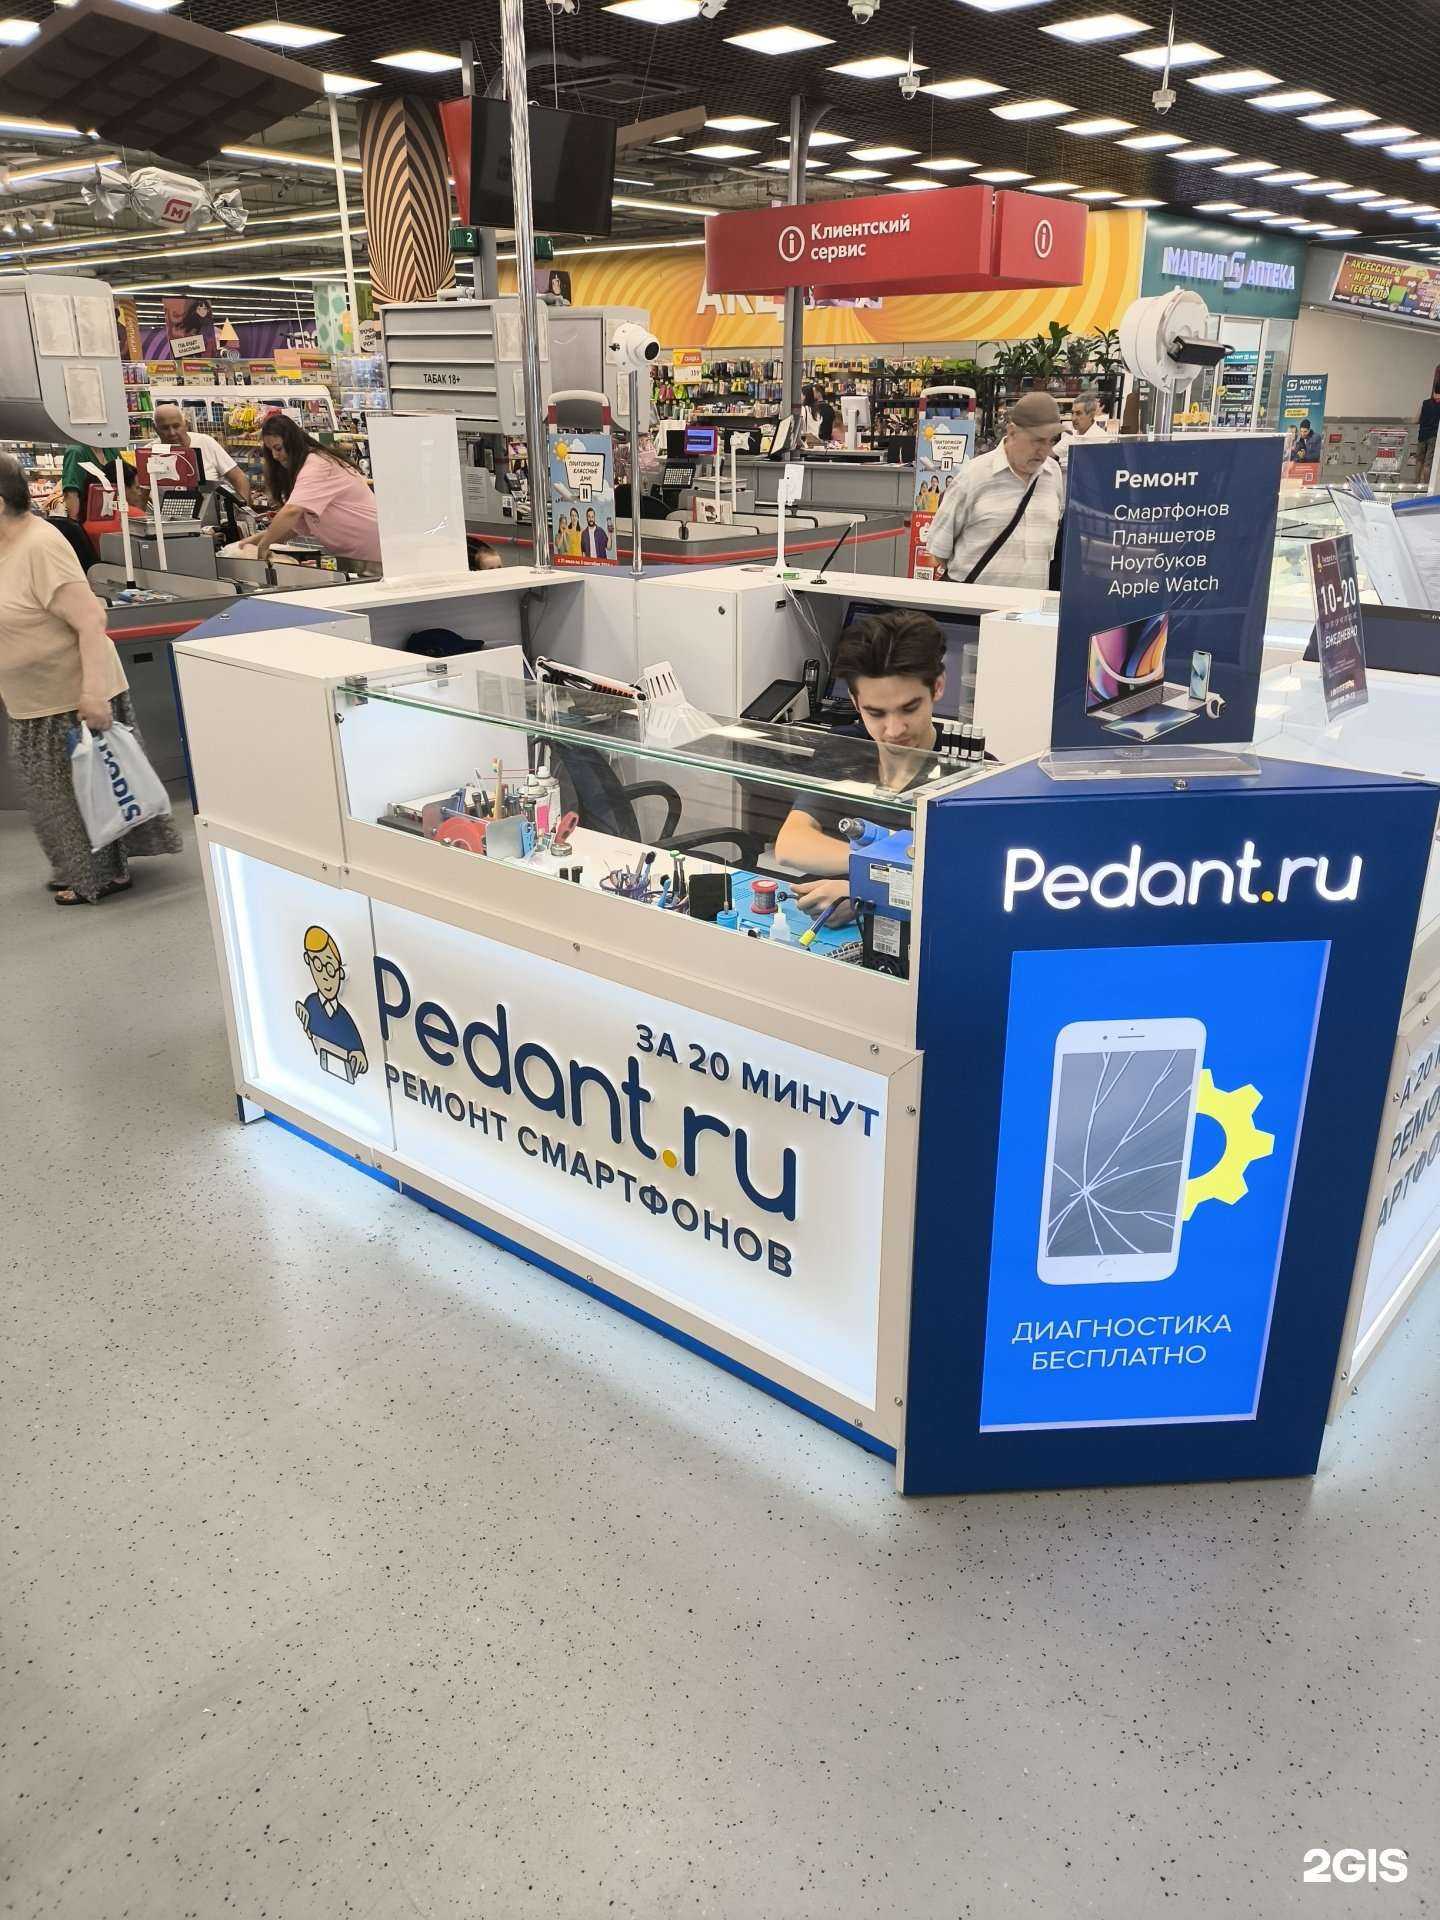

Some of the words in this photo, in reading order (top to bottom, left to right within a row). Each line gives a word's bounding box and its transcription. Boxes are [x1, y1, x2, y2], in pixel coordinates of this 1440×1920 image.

[466, 232, 473, 243] 2
[811, 213, 911, 240] Клиентский
[811, 242, 866, 262] сервис
[1161, 247, 1228, 281] МАГНИТ
[1246, 260, 1295, 289] АПТЕКА
[1350, 259, 1405, 277] АКСЕССУАРЫ
[1353, 272, 1393, 287] ИГРУШКИ
[1350, 283, 1390, 299] ТЕКСТИЛЬ
[423, 373, 447, 384] ТАБАК
[448, 374, 461, 385] 18+
[1114, 470, 1199, 488] Ремонт
[1114, 502, 1229, 522] Смартфонов
[1112, 529, 1216, 547] Планшетов
[1110, 553, 1207, 573] Ноутбуков
[1108, 579, 1160, 598] Apple
[1165, 576, 1219, 592] Watch
[1320, 576, 1357, 616] 10-20
[1325, 625, 1358, 648] ЕЖЕДНЕВНО
[1003, 840, 1363, 912] Pedant.ru
[635, 1023, 680, 1063] ЗА
[688, 1044, 730, 1081] 20
[741, 1062, 880, 1137] МИНУТ
[1414, 1051, 1433, 1092] 20
[373, 955, 797, 1222] Pedant.ru
[1388, 1085, 1440, 1174] РЕМО
[384, 1062, 508, 1142] РЕМОНТ
[517, 1125, 793, 1278] СМАРТФОНОВ
[1377, 1130, 1440, 1232] АРТФО
[1011, 1313, 1232, 1344] ДИАГНОСТИКА
[1032, 1345, 1207, 1370] БЕСПЛАТНО
